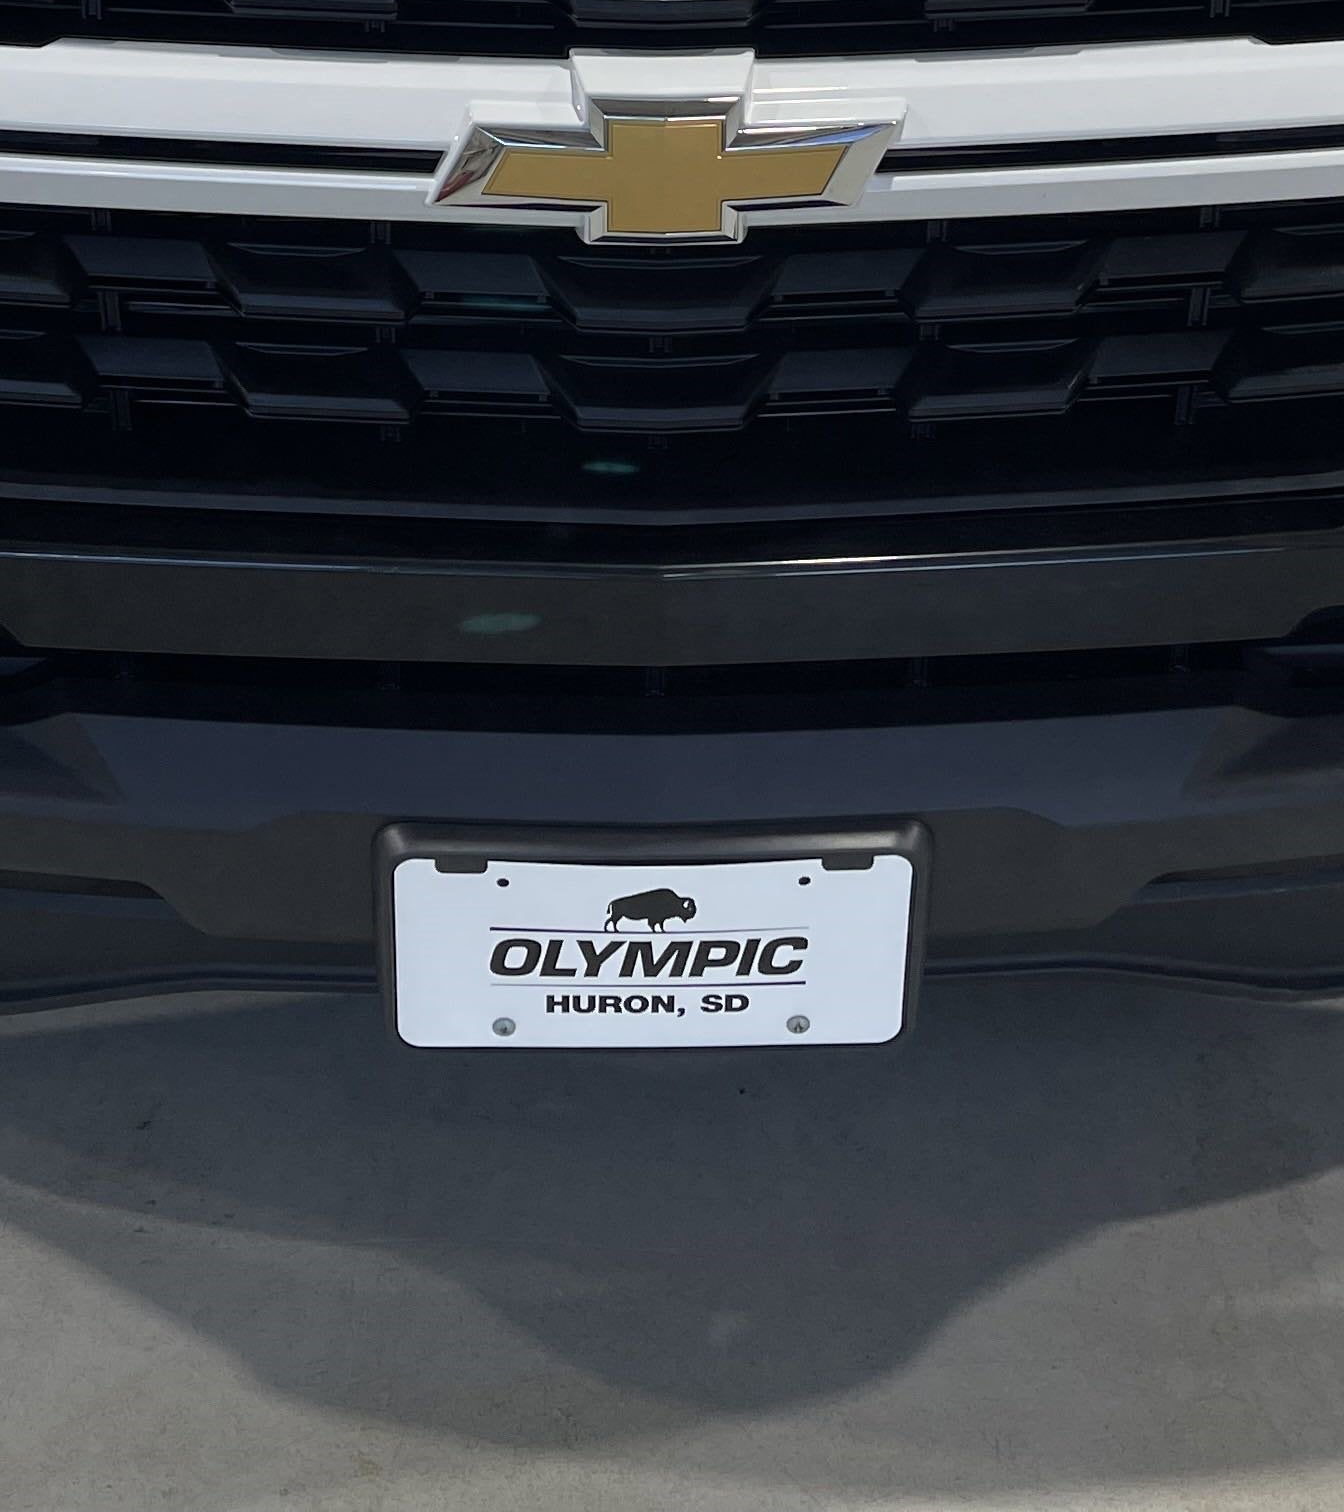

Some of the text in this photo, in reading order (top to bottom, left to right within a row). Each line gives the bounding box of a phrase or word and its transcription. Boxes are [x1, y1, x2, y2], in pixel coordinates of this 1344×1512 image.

[489, 936, 808, 978] OLYMPIC
[545, 995, 749, 1018] HURON, SD
